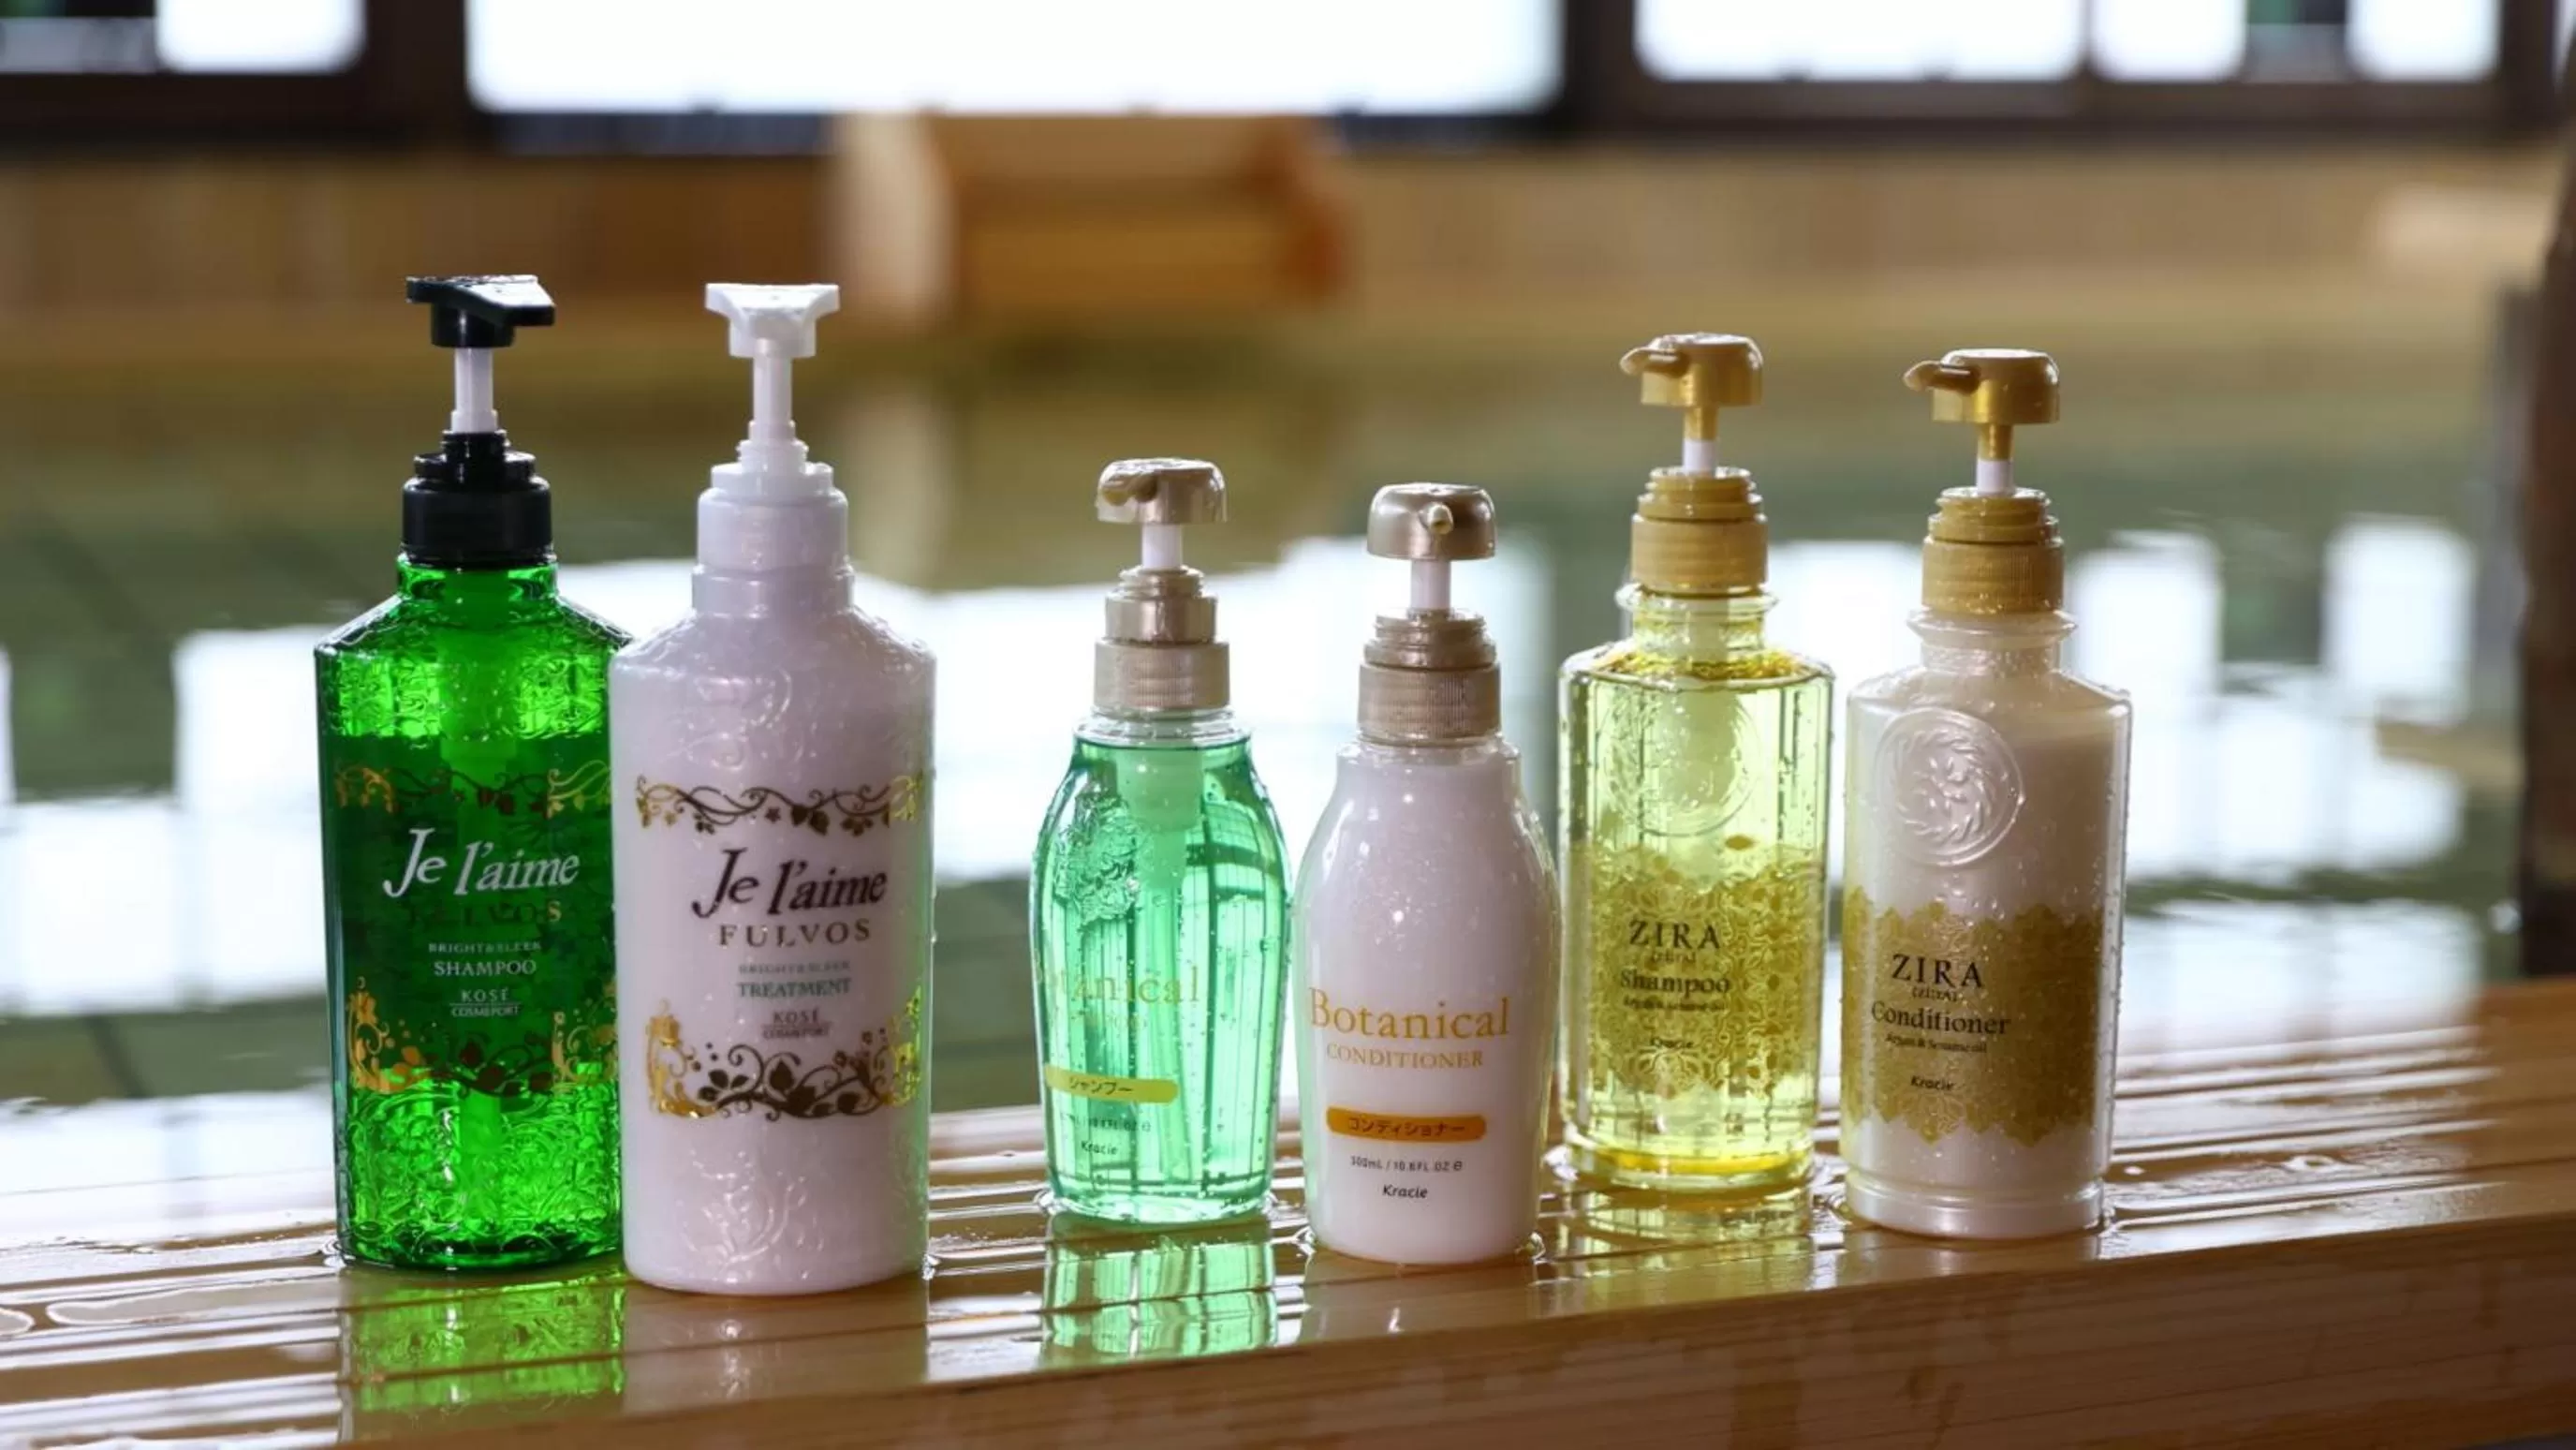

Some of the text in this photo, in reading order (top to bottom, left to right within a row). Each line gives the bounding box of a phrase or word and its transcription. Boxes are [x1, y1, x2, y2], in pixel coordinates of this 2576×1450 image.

[383, 827, 581, 898] Je l'aime
[692, 847, 888, 918] Je l'aime
[719, 918, 870, 948] FULVOS
[1628, 918, 1720, 951] ZIRA
[434, 959, 537, 977] SHAMPOO
[1892, 953, 1983, 988] ZIRA
[736, 977, 851, 998] TREATMENT
[1621, 969, 1730, 999] Shampoo
[1309, 986, 1510, 1040] Botanical
[1871, 1000, 2012, 1035] Conditioner
[1327, 1043, 1483, 1069] CONDITIONER
[1349, 1117, 1465, 1136] コンディショナー
[1382, 1184, 1428, 1199] Kracie
